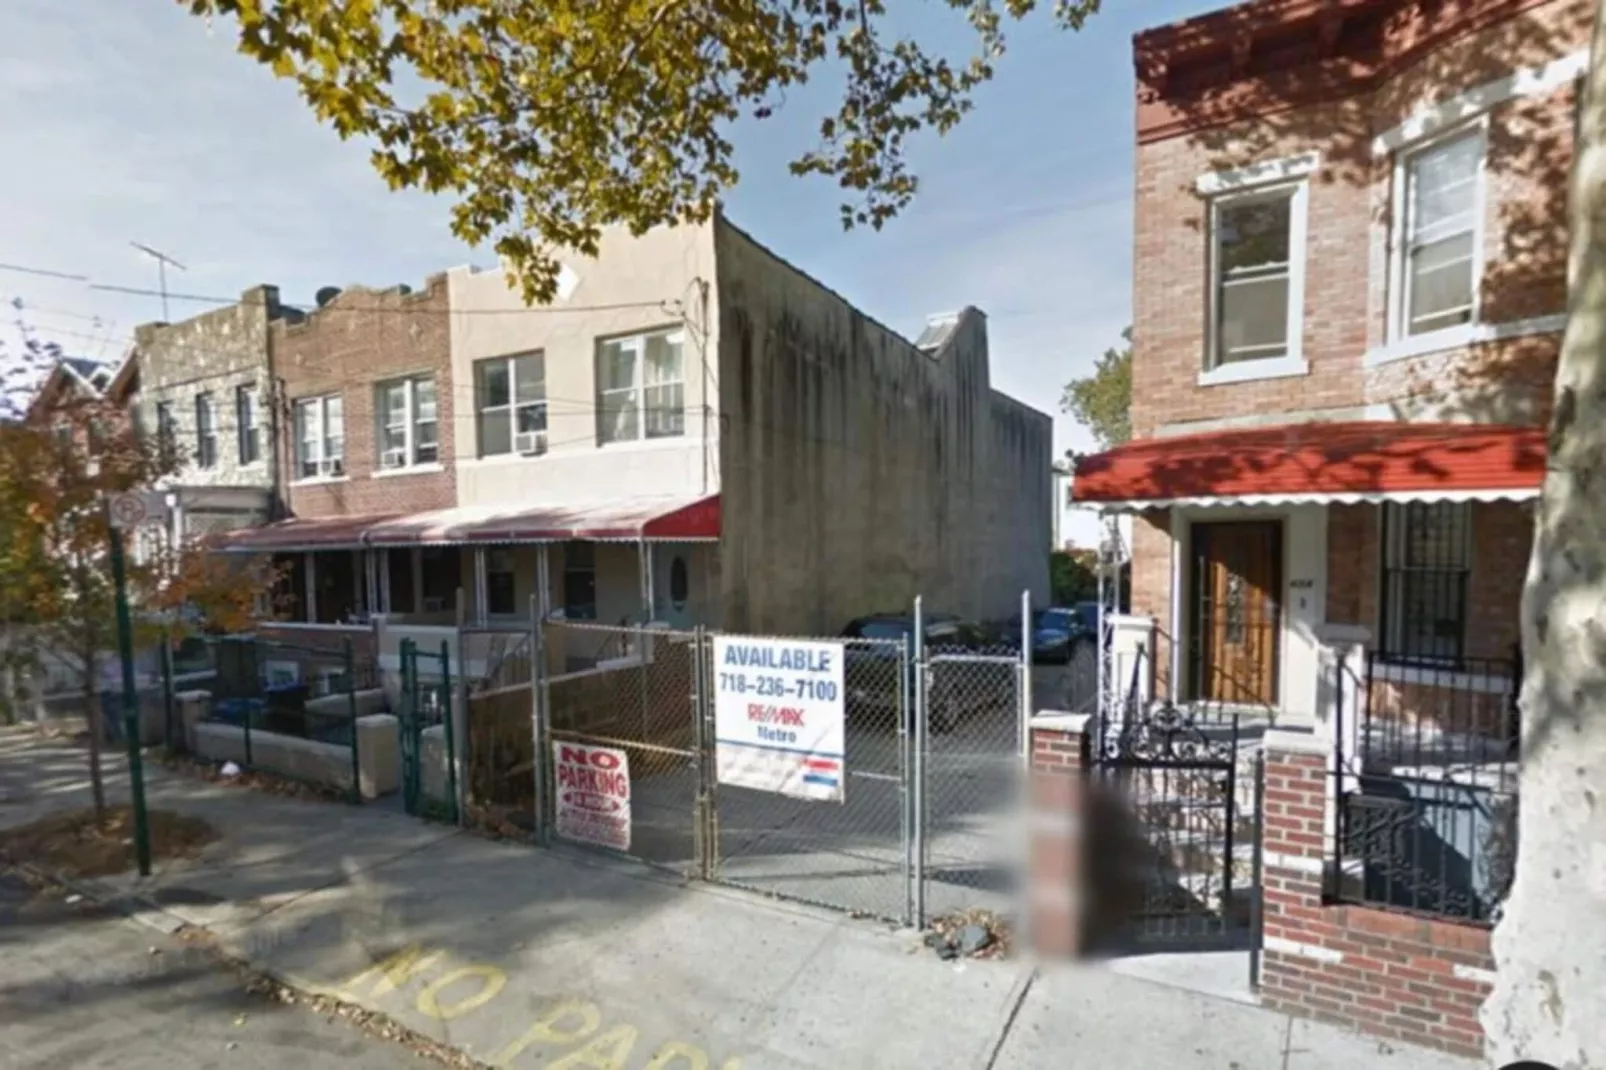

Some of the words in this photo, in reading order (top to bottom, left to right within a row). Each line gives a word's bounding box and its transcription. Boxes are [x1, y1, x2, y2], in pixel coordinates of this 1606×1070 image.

[724, 645, 831, 672] AVAILABLE
[719, 673, 837, 702] 718-236-7100
[757, 725, 797, 743] Metro
[561, 745, 620, 769] NO
[558, 763, 627, 798] PARKING
